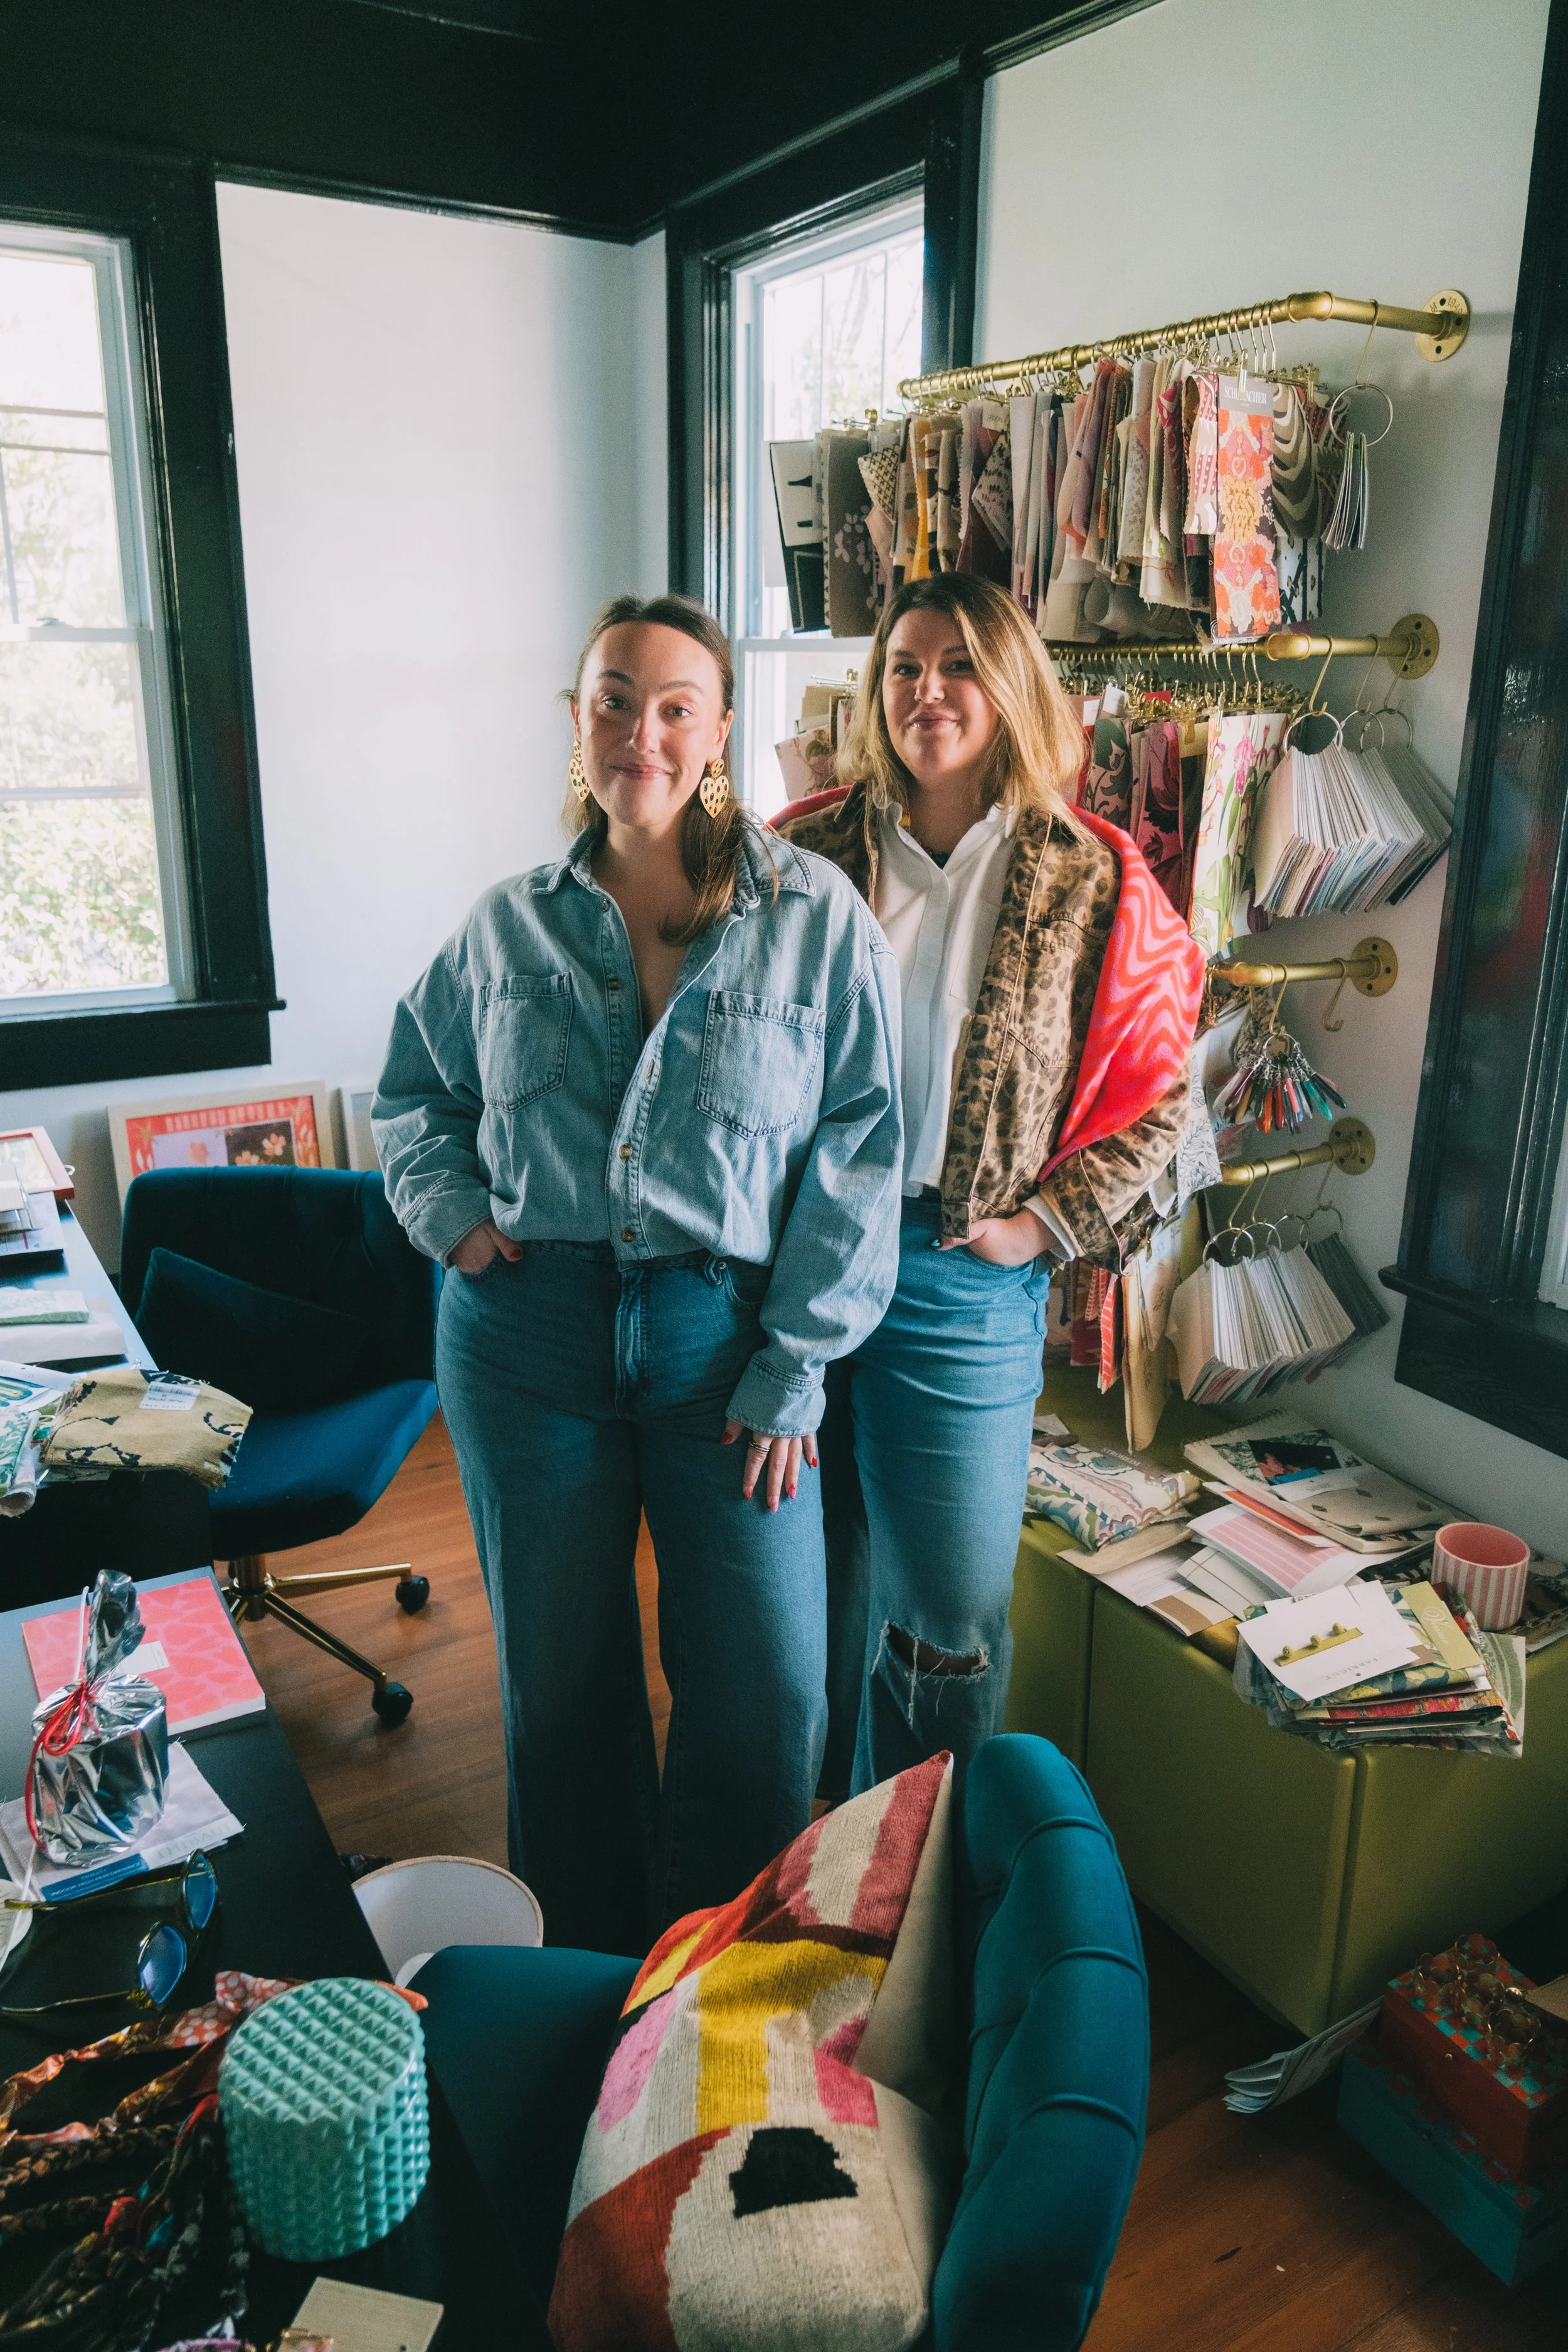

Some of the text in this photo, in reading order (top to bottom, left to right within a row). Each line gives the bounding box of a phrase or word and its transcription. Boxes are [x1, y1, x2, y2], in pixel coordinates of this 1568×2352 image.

[1224, 386, 1267, 405] SCHUACHER
[1325, 1658, 1378, 1680] FABRICUT
[156, 1821, 231, 1859] THIBAUT
